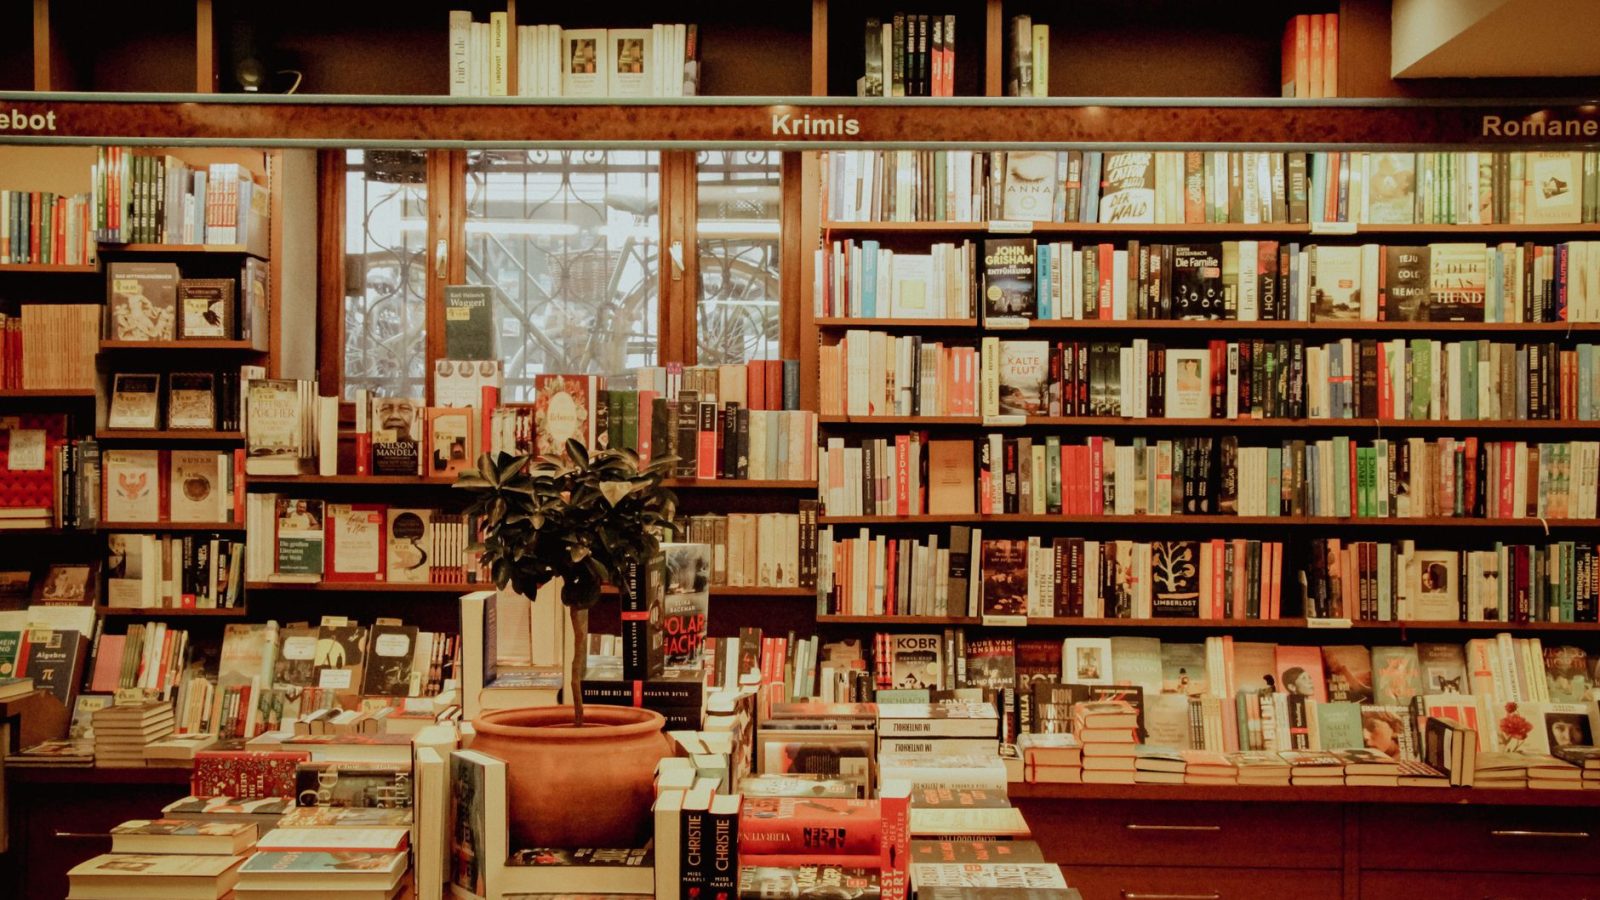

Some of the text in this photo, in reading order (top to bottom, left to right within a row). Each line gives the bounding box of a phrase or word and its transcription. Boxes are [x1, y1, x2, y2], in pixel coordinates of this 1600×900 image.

[455, 61, 466, 85] Fairy
[772, 114, 860, 136] Krimis
[1482, 115, 1598, 137] Romane
[1007, 185, 1051, 193] ANNA
[1111, 201, 1148, 223] WALD
[994, 246, 1025, 256] JOHN
[985, 254, 1034, 265] GRISHAM
[1175, 257, 1219, 267] Die Familie
[1399, 254, 1418, 263] TEJU
[987, 267, 1032, 275] ENTFÜHRUNG
[1447, 264, 1478, 273] DER
[1398, 270, 1419, 279] COLE
[1264, 276, 1274, 311] HOLLY
[1437, 293, 1483, 304] HUND
[450, 299, 485, 308] Waggerl
[1007, 356, 1040, 366] KALTE
[1011, 366, 1036, 375] FLUT
[251, 407, 295, 418] ARCHER
[379, 441, 414, 450] NELSON
[376, 449, 418, 457] MANDELA
[1358, 454, 1366, 487] SERVICE
[896, 638, 937, 650] KOBR
[994, 638, 1013, 647] VAN
[37, 652, 67, 660] Algebra
[1052, 689, 1073, 703] DON
[1020, 695, 1029, 723] VILLA
[1038, 703, 1077, 719] WINSLO
[893, 722, 930, 732] IM UNTERHOLZ
[895, 743, 932, 753] IM UNTERHOLZ
[803, 827, 846, 838] OLSEN
[688, 814, 702, 866] CHRISTIE
[715, 818, 730, 872] CHRISTIE
